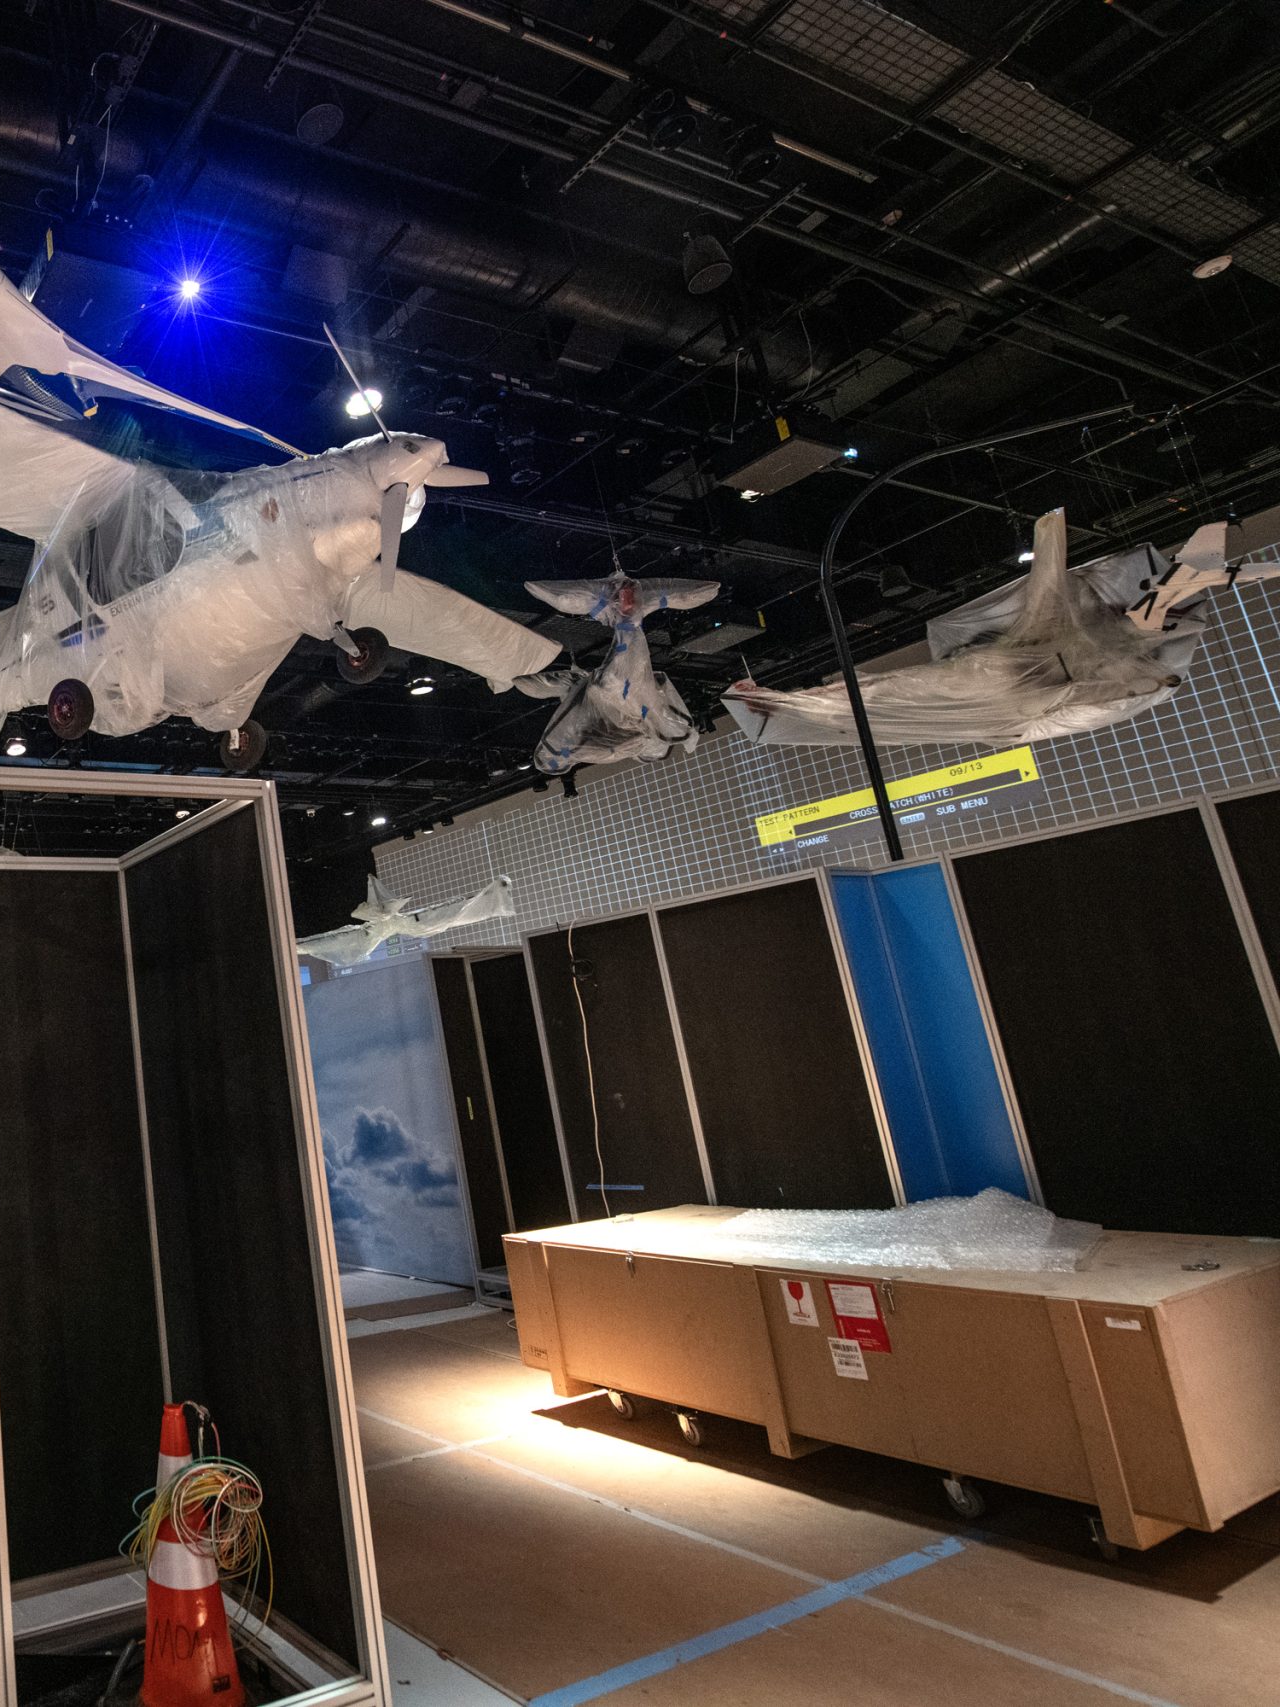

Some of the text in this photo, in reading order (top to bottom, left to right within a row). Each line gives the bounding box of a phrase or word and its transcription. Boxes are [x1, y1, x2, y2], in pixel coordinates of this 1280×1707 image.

[949, 761, 984, 777] 09/13
[849, 787, 955, 820] CROSS ATCH(WHITE)
[935, 796, 989, 816] SUB MENU
[758, 806, 820, 827] TEST PATTERN
[797, 834, 830, 849] CHANGE
